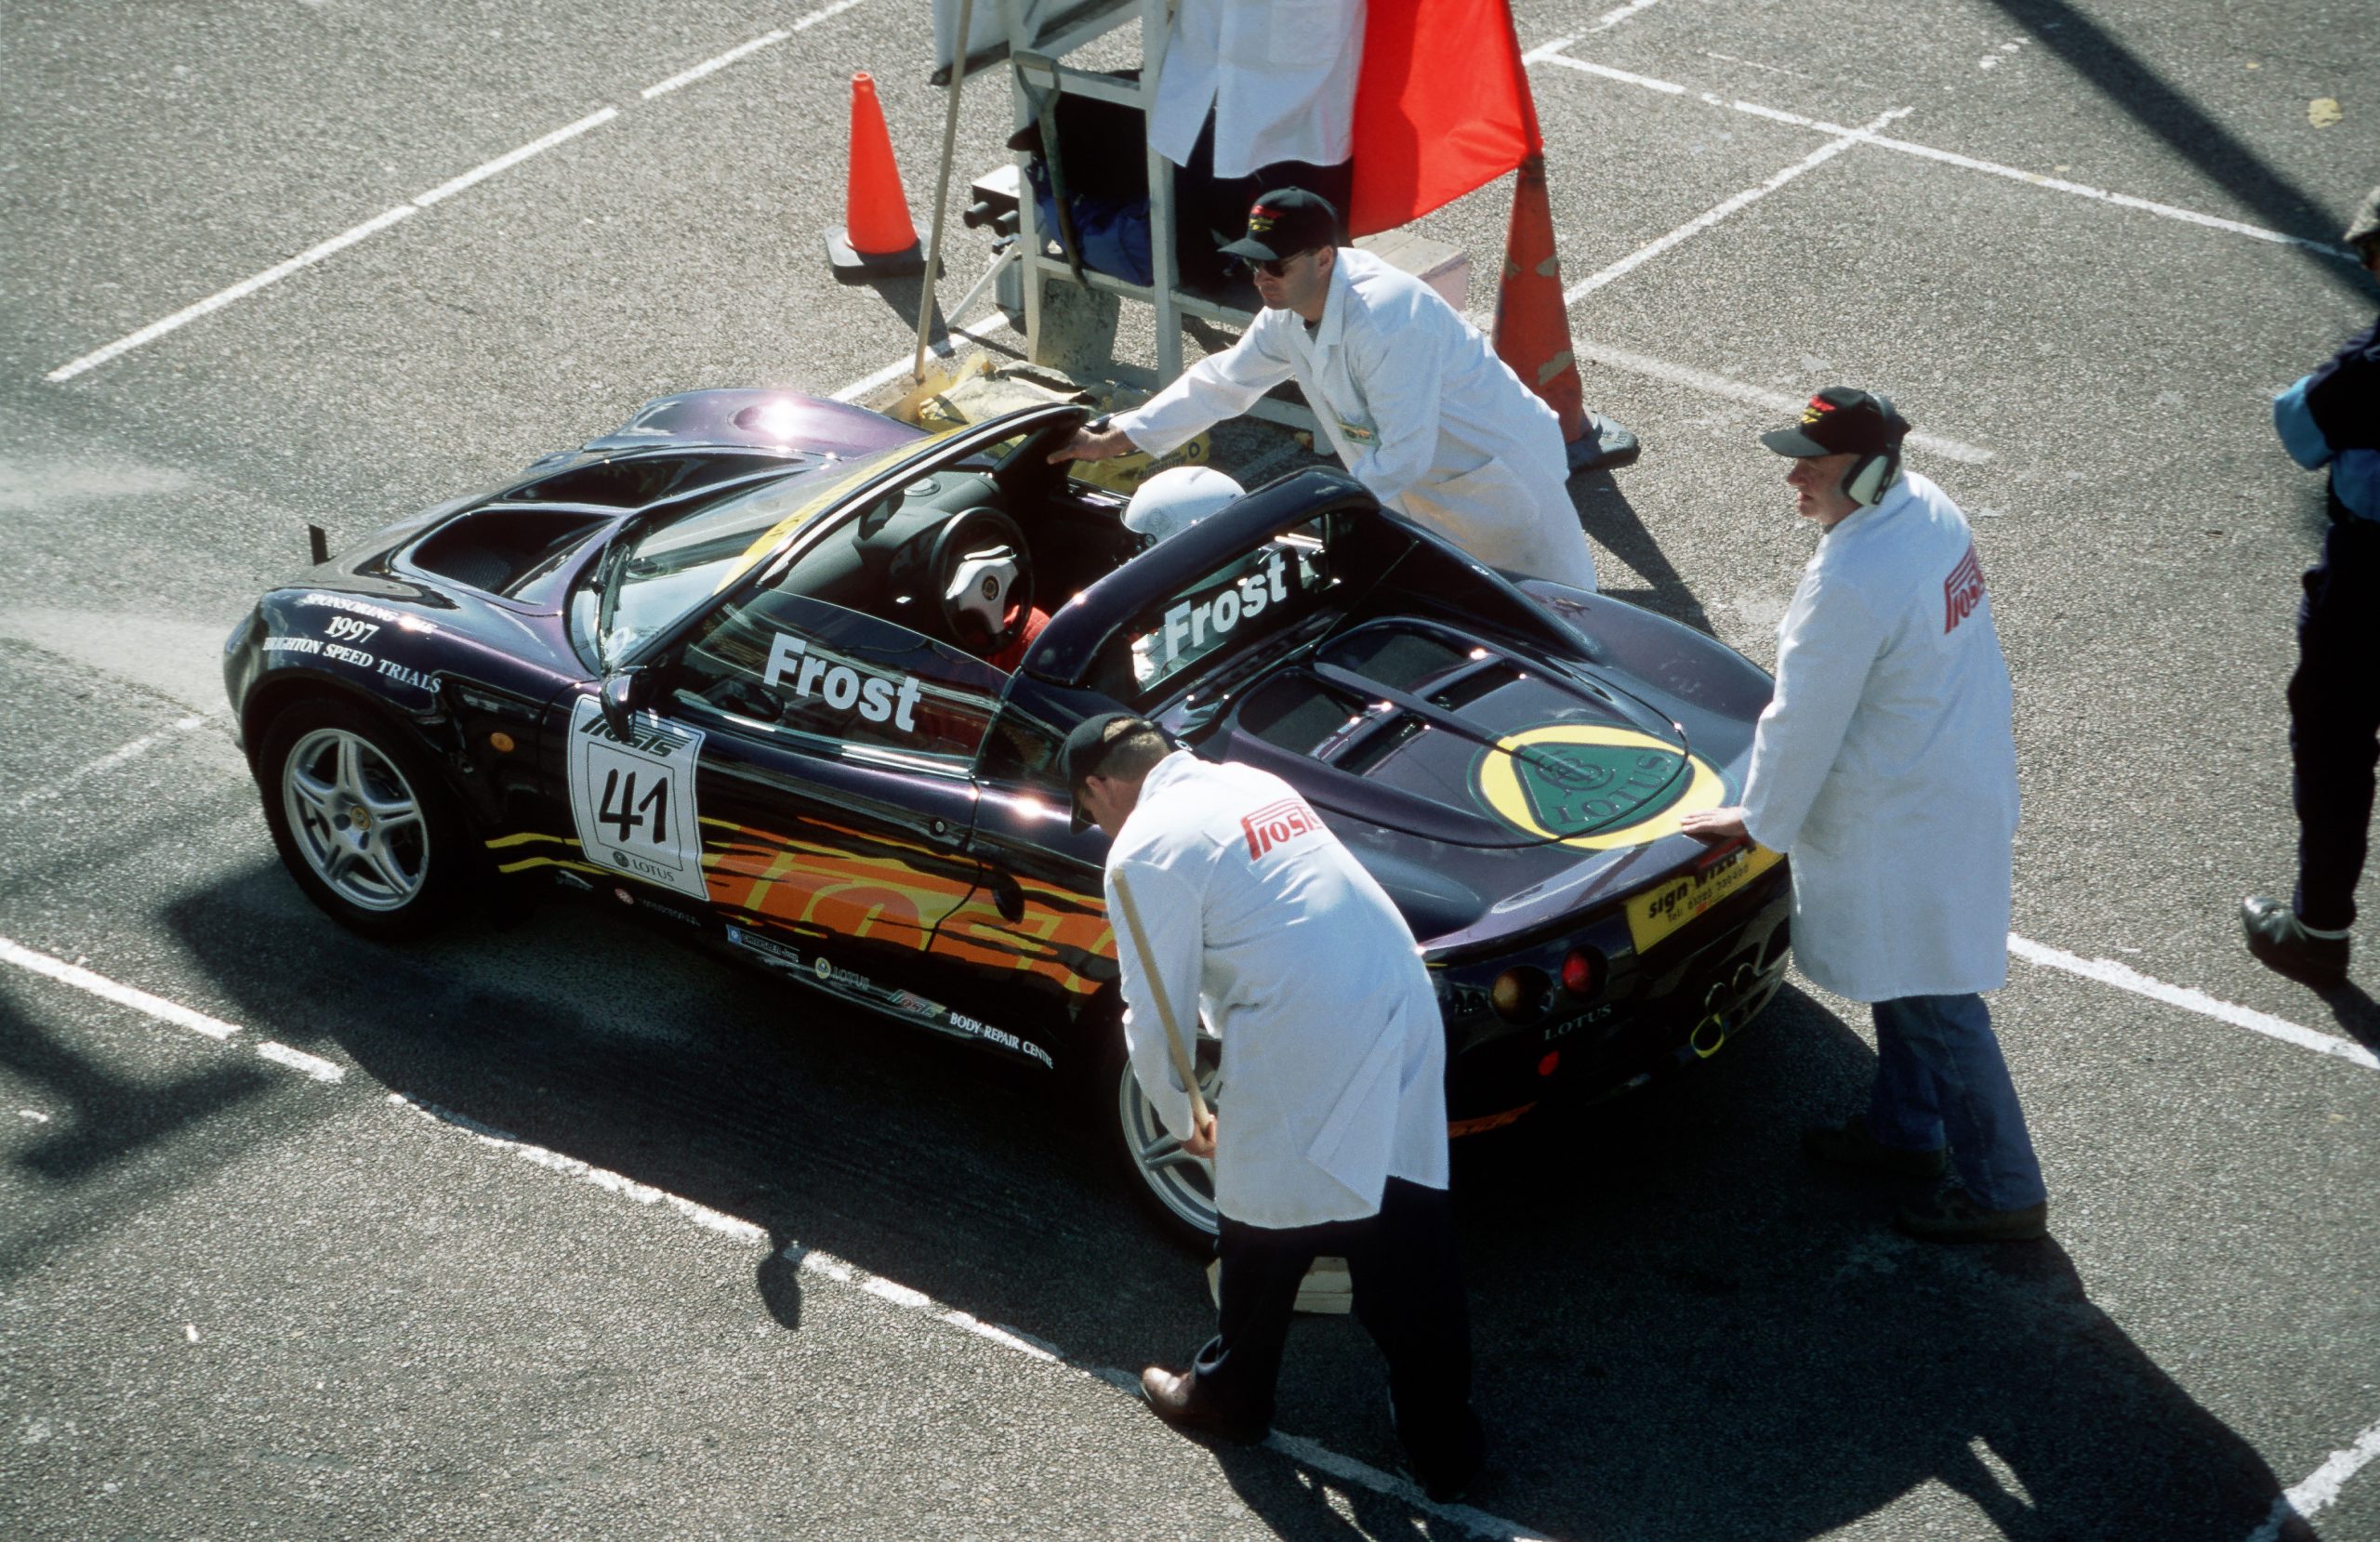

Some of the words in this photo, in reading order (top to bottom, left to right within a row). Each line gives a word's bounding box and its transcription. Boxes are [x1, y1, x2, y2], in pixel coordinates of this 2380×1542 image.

[300, 592, 398, 622] SPONSORING
[324, 615, 379, 643] 1997
[1165, 552, 1287, 661] Frost
[262, 637, 324, 654] BRIGHTON
[323, 643, 373, 667] SPEED
[377, 659, 442, 693] TRIALS
[763, 632, 921, 732] Frost
[599, 768, 668, 844] 41
[1551, 755, 1673, 824] LOTUS
[632, 859, 675, 882] LOTUS
[1647, 882, 1688, 919] sign
[950, 1011, 982, 1034] BODY
[984, 1024, 1020, 1049] REPAIR
[1023, 1040, 1054, 1070] CENTRE
[1544, 1003, 1613, 1042] LOTUS
